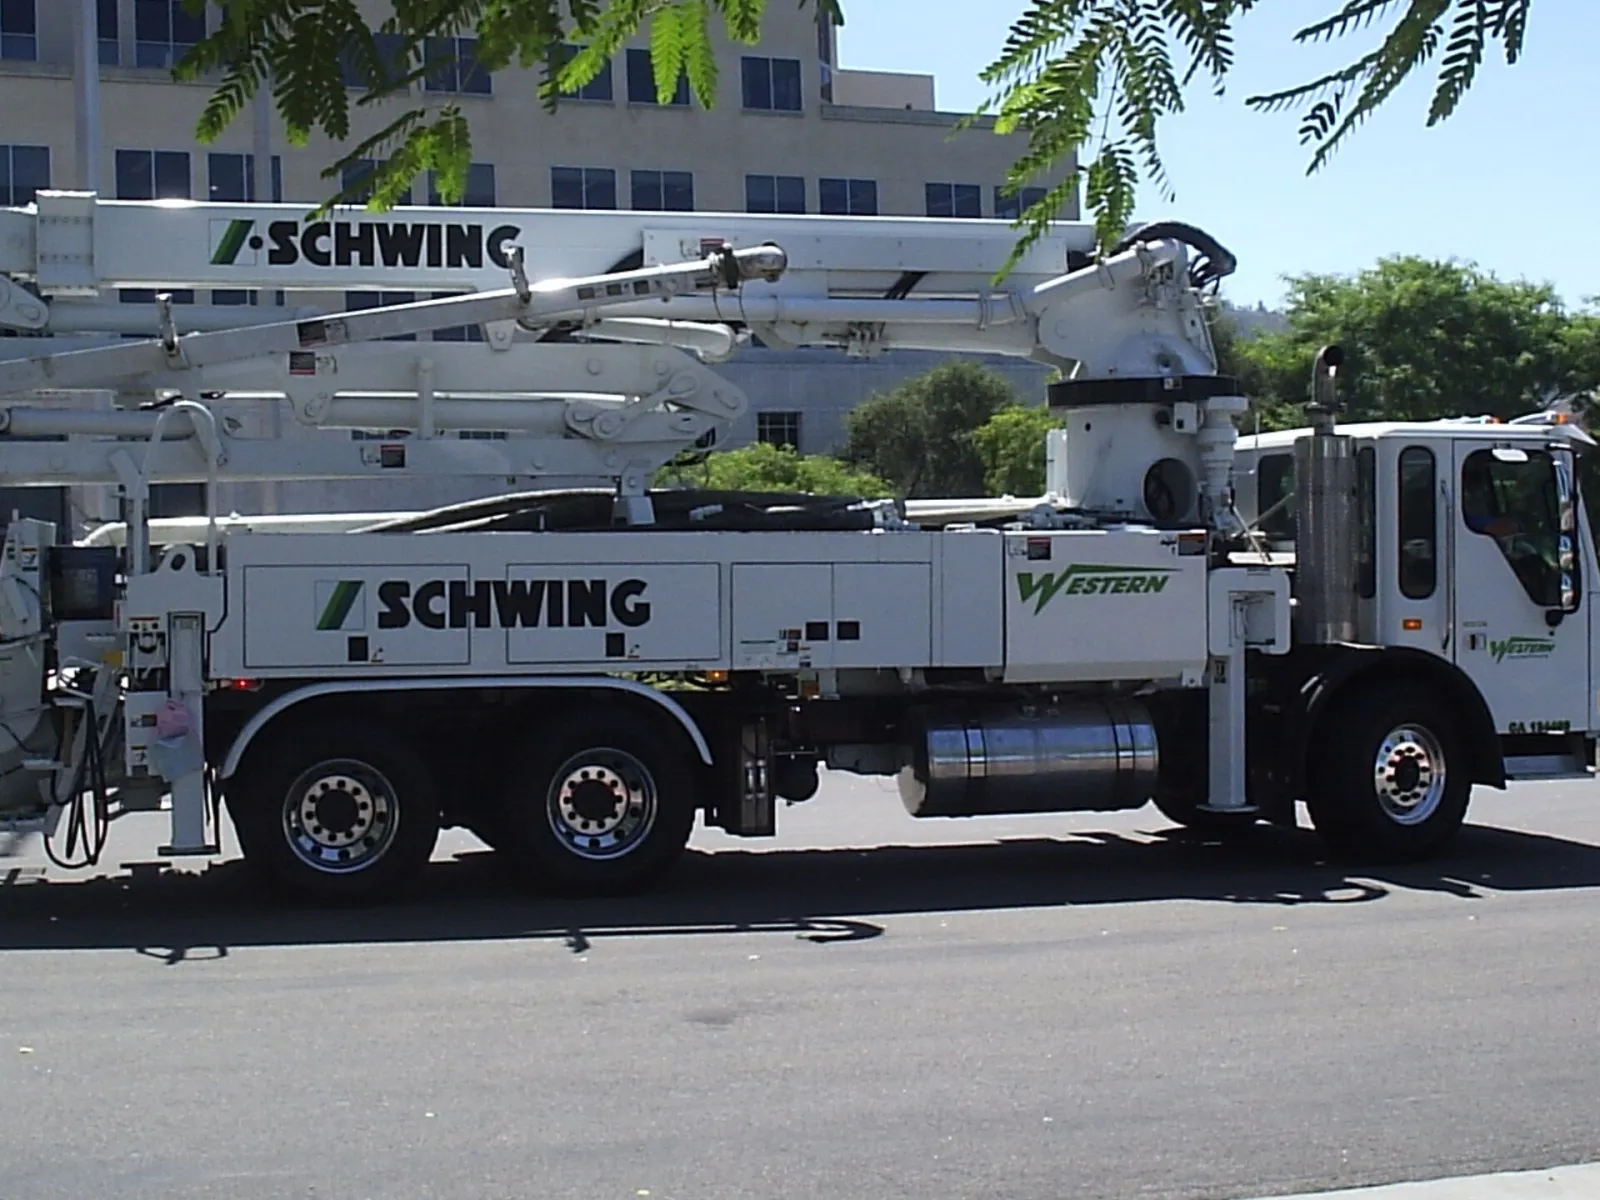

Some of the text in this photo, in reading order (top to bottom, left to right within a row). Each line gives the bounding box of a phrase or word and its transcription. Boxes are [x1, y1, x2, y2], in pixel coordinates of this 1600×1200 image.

[267, 221, 525, 268] SCHWING
[377, 579, 650, 629] SCHWING
[1016, 563, 1183, 616] WESTERN
